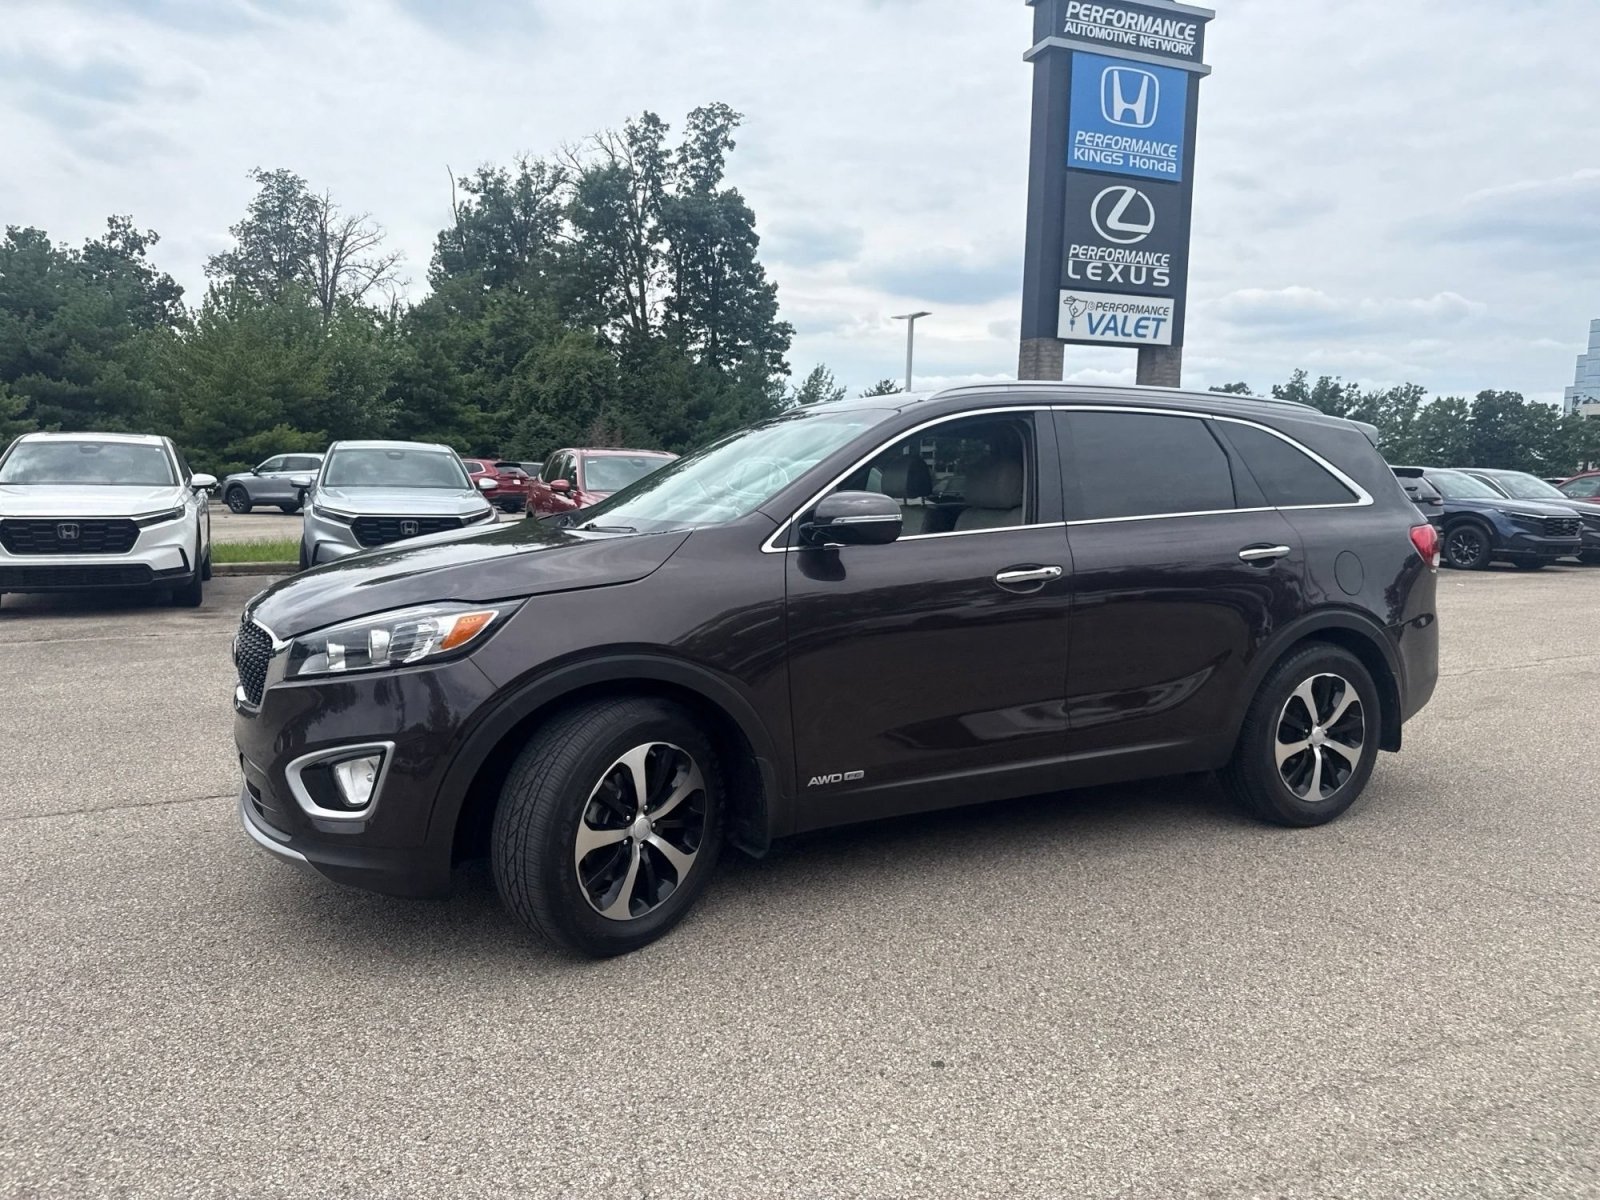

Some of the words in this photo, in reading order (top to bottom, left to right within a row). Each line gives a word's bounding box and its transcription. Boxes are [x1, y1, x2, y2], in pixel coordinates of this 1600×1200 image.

[1065, 1, 1197, 41] PERFORMANCE
[1064, 22, 1137, 46] AUTOMOTIVE
[1139, 35, 1193, 56] NETWORK
[1074, 130, 1178, 158] PERFORMANCE
[1073, 147, 1124, 165] KINGS
[1129, 154, 1176, 173] Honda
[1068, 243, 1171, 266] PERFORMANCE
[1067, 260, 1170, 287] LEXUS
[1095, 301, 1170, 316] PERFORMANCE
[1087, 312, 1167, 339] VALET
[807, 773, 843, 787] AWD
